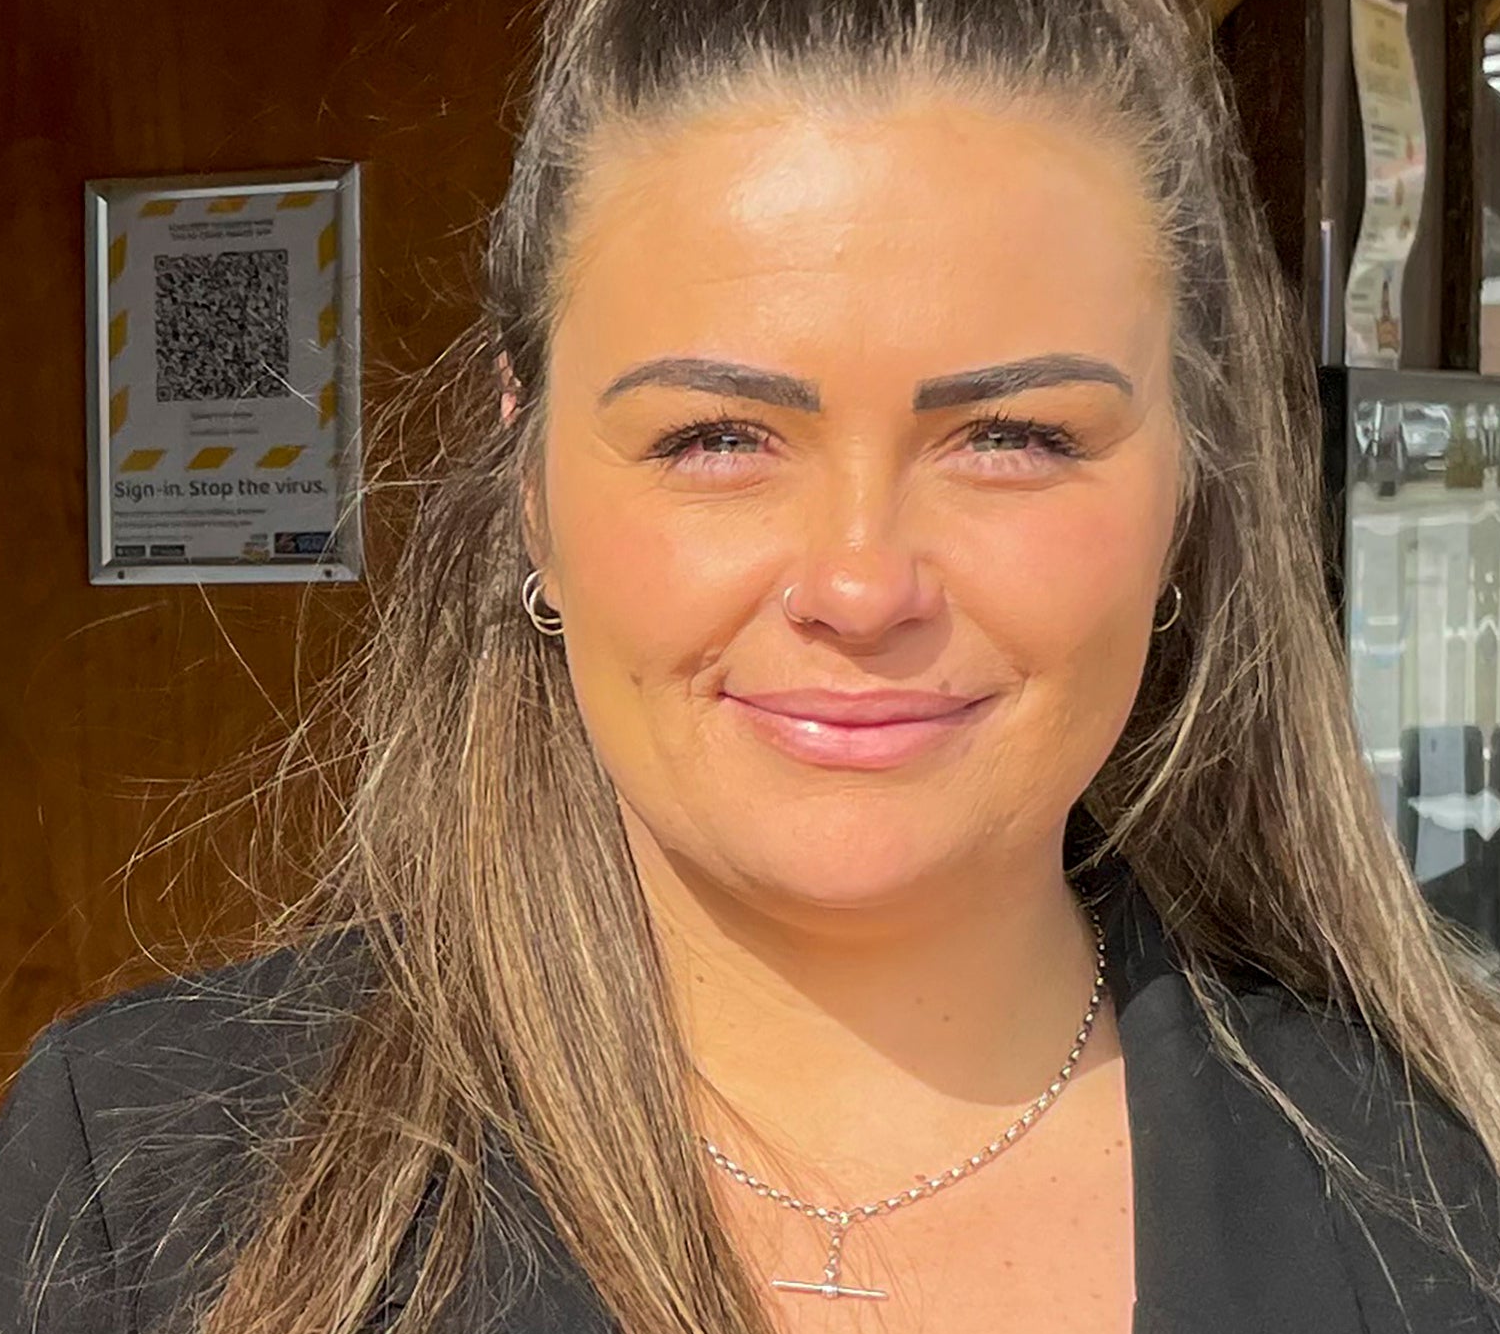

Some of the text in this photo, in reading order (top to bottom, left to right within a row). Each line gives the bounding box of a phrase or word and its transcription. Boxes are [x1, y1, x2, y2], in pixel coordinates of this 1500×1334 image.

[190, 479, 233, 499] Stop
[238, 478, 270, 495] the
[274, 478, 328, 495] virus.
